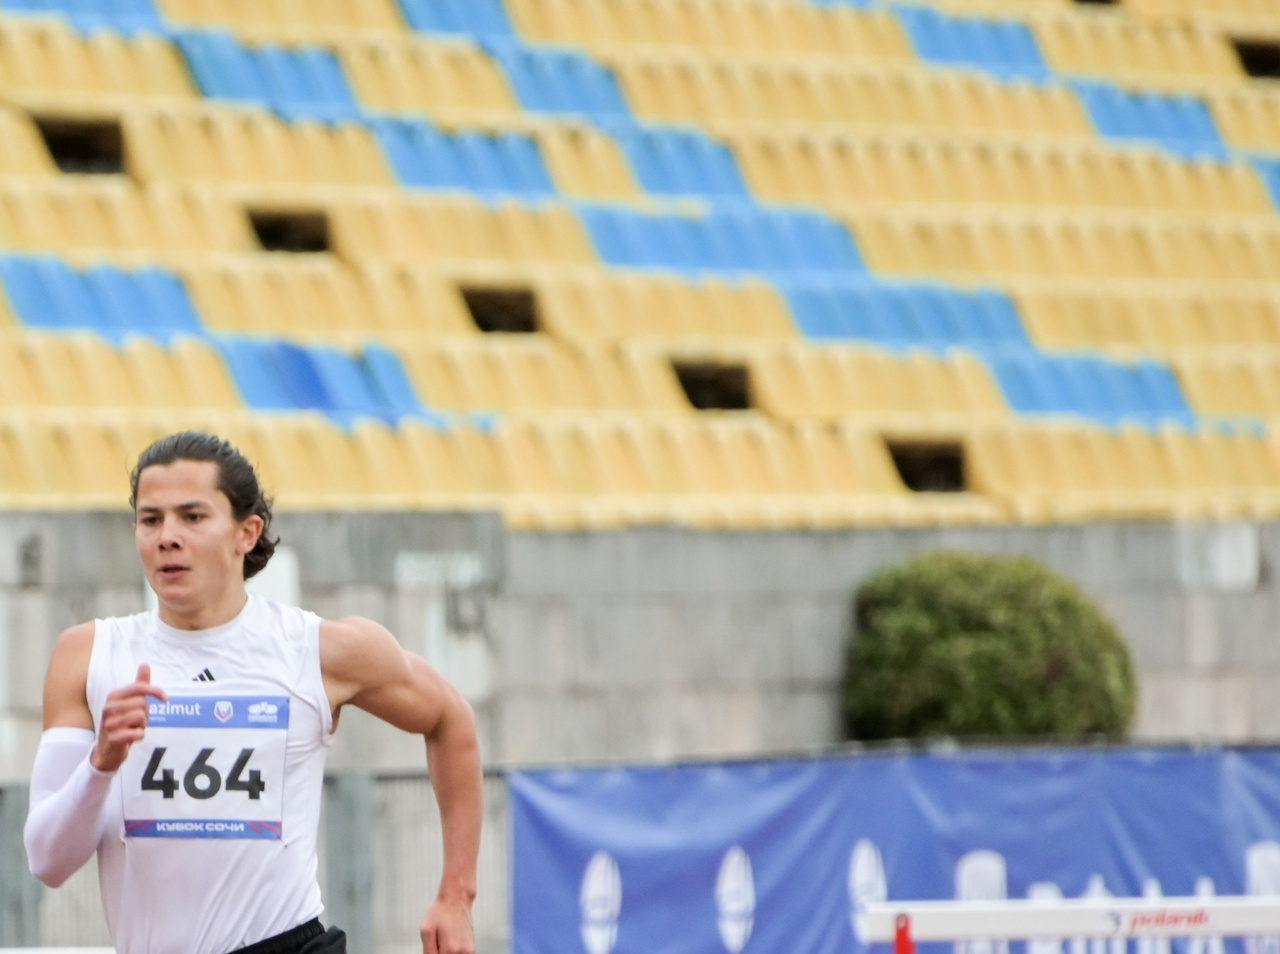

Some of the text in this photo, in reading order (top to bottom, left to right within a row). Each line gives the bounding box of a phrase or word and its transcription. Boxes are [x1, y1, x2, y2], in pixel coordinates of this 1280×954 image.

[148, 700, 201, 716] azimut
[141, 747, 265, 800] 464
[156, 822, 244, 832] КУБОК СОЧИ
